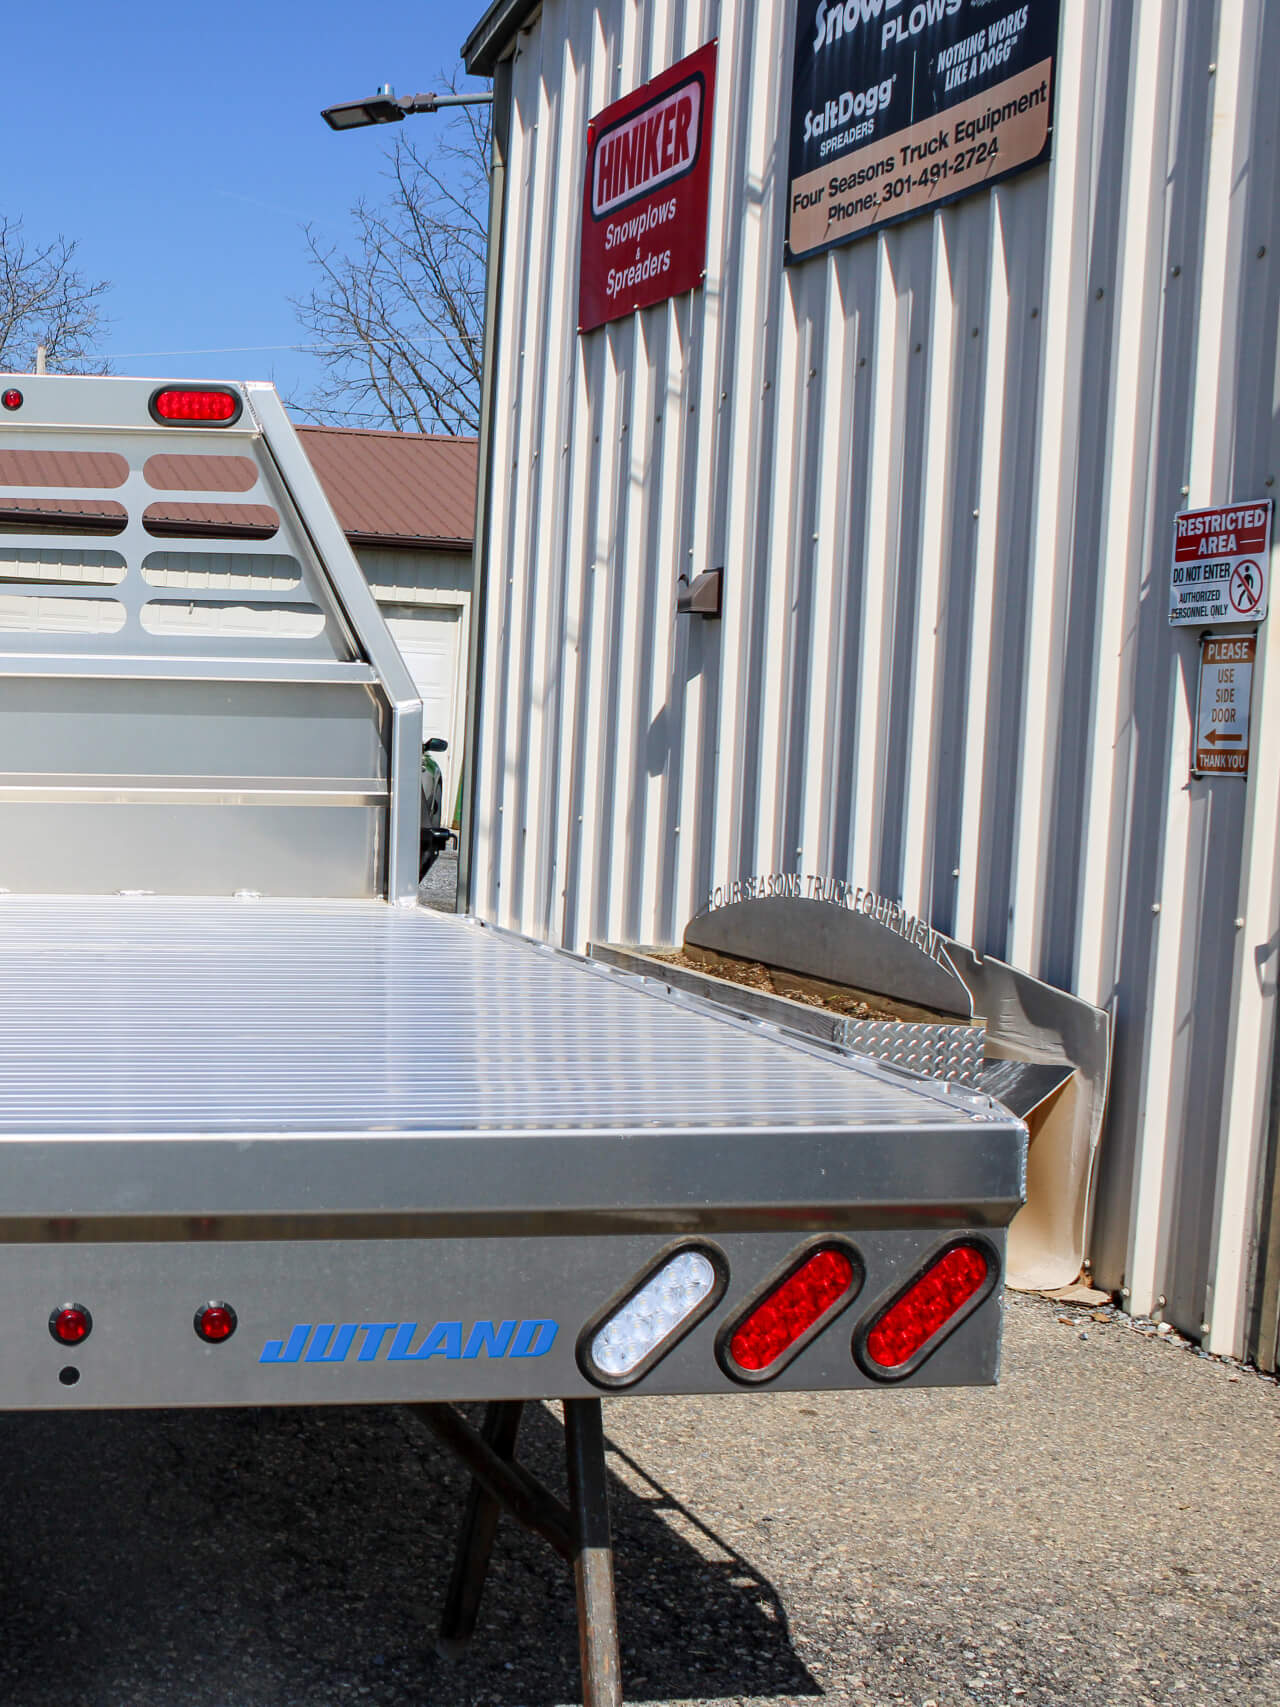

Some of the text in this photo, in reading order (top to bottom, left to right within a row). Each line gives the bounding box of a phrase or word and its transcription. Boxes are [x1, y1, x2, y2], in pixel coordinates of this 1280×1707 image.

[813, 0, 903, 54] Snow
[937, 4, 1029, 74] NOTHING WORKS
[944, 61, 968, 92] LIKE
[969, 56, 978, 80] A
[793, 80, 1047, 214] Four Seasons Truck Equipment
[820, 118, 875, 156] SPREADERS
[597, 96, 692, 207] HINIKER
[828, 137, 1000, 221] Phone: 301-491-2724
[605, 198, 677, 250] Snowplows
[635, 247, 641, 260] &
[606, 250, 671, 299] Spreaders
[1178, 509, 1266, 537] RESTRICTED
[1198, 534, 1237, 555] AREA
[1173, 563, 1231, 583] DO NOT ENTER
[1179, 590, 1220, 604] AUTHORIZED
[1210, 604, 1229, 617] ONLY
[1207, 642, 1249, 660] PLEASE
[1218, 669, 1235, 683] USE
[1215, 688, 1235, 703] SIDE
[1211, 708, 1237, 723] DOOR
[1199, 753, 1246, 769] THANK YOU
[258, 1319, 559, 1363] JUTLAND
